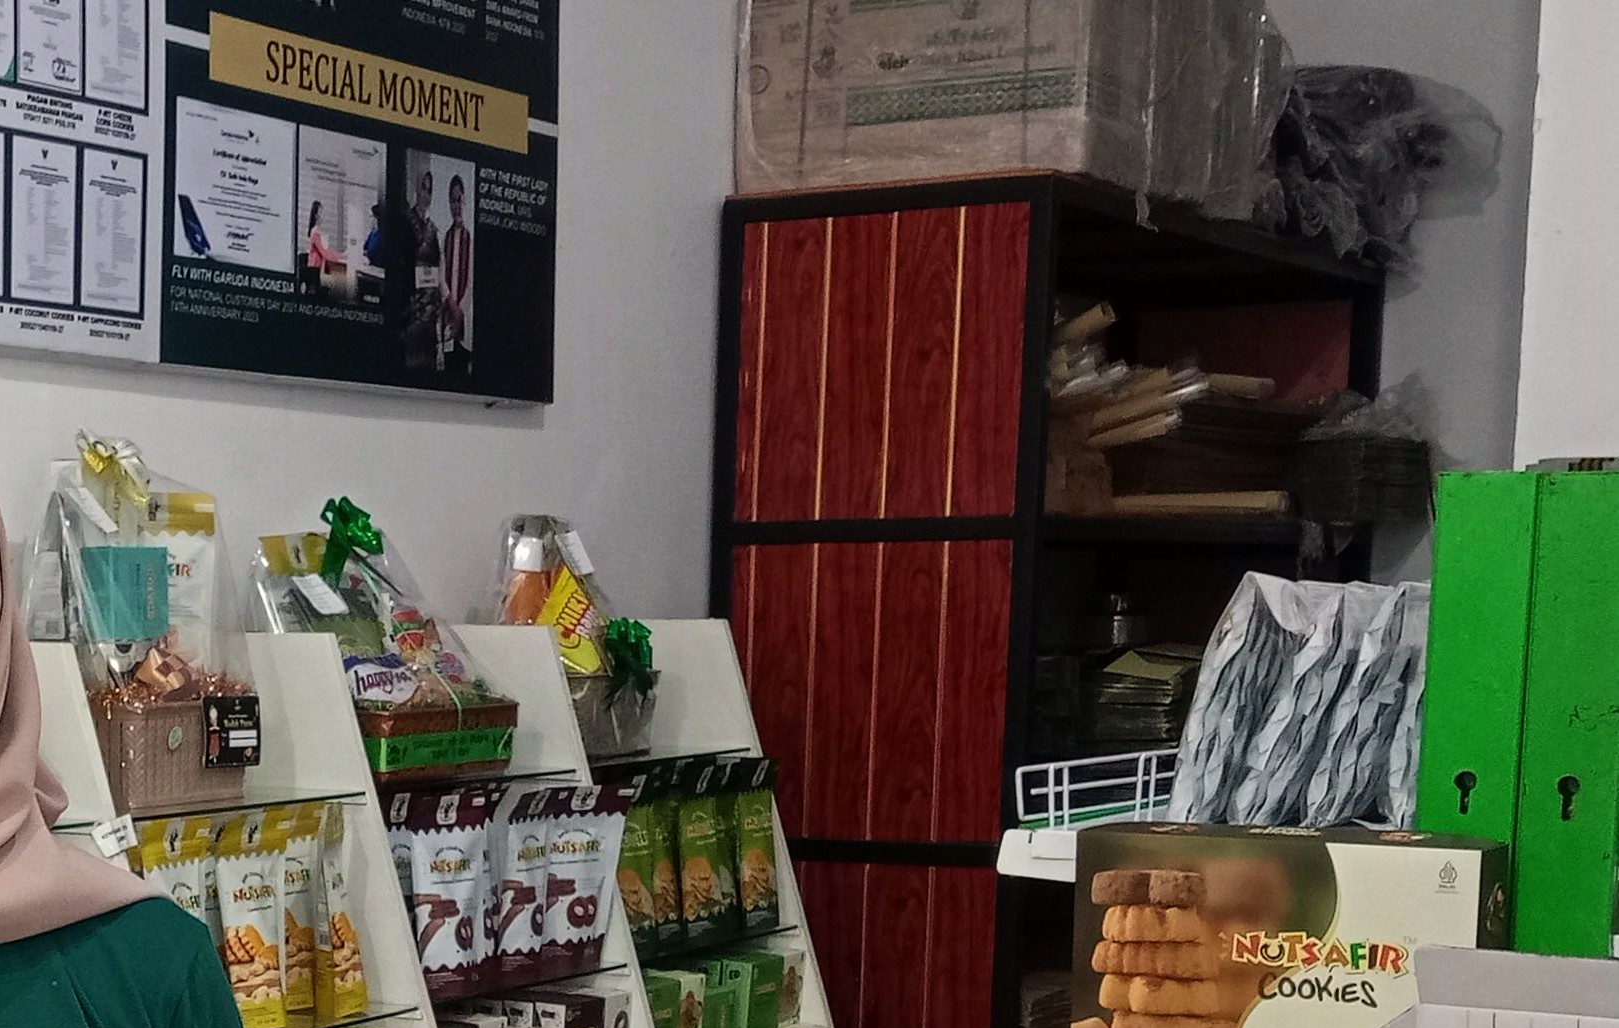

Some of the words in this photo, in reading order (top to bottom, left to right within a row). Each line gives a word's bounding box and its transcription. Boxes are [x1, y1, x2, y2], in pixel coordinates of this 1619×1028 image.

[265, 39, 372, 107] SPECIAL
[378, 68, 485, 133] MOMENT
[171, 263, 189, 279] FLY
[189, 267, 213, 281] WITH
[213, 270, 250, 287] GARUDA
[250, 276, 295, 294] INDONESIA
[354, 669, 394, 695] happy
[1231, 931, 1409, 976] NUTSAFIR
[1257, 973, 1378, 1008] COOKIES
